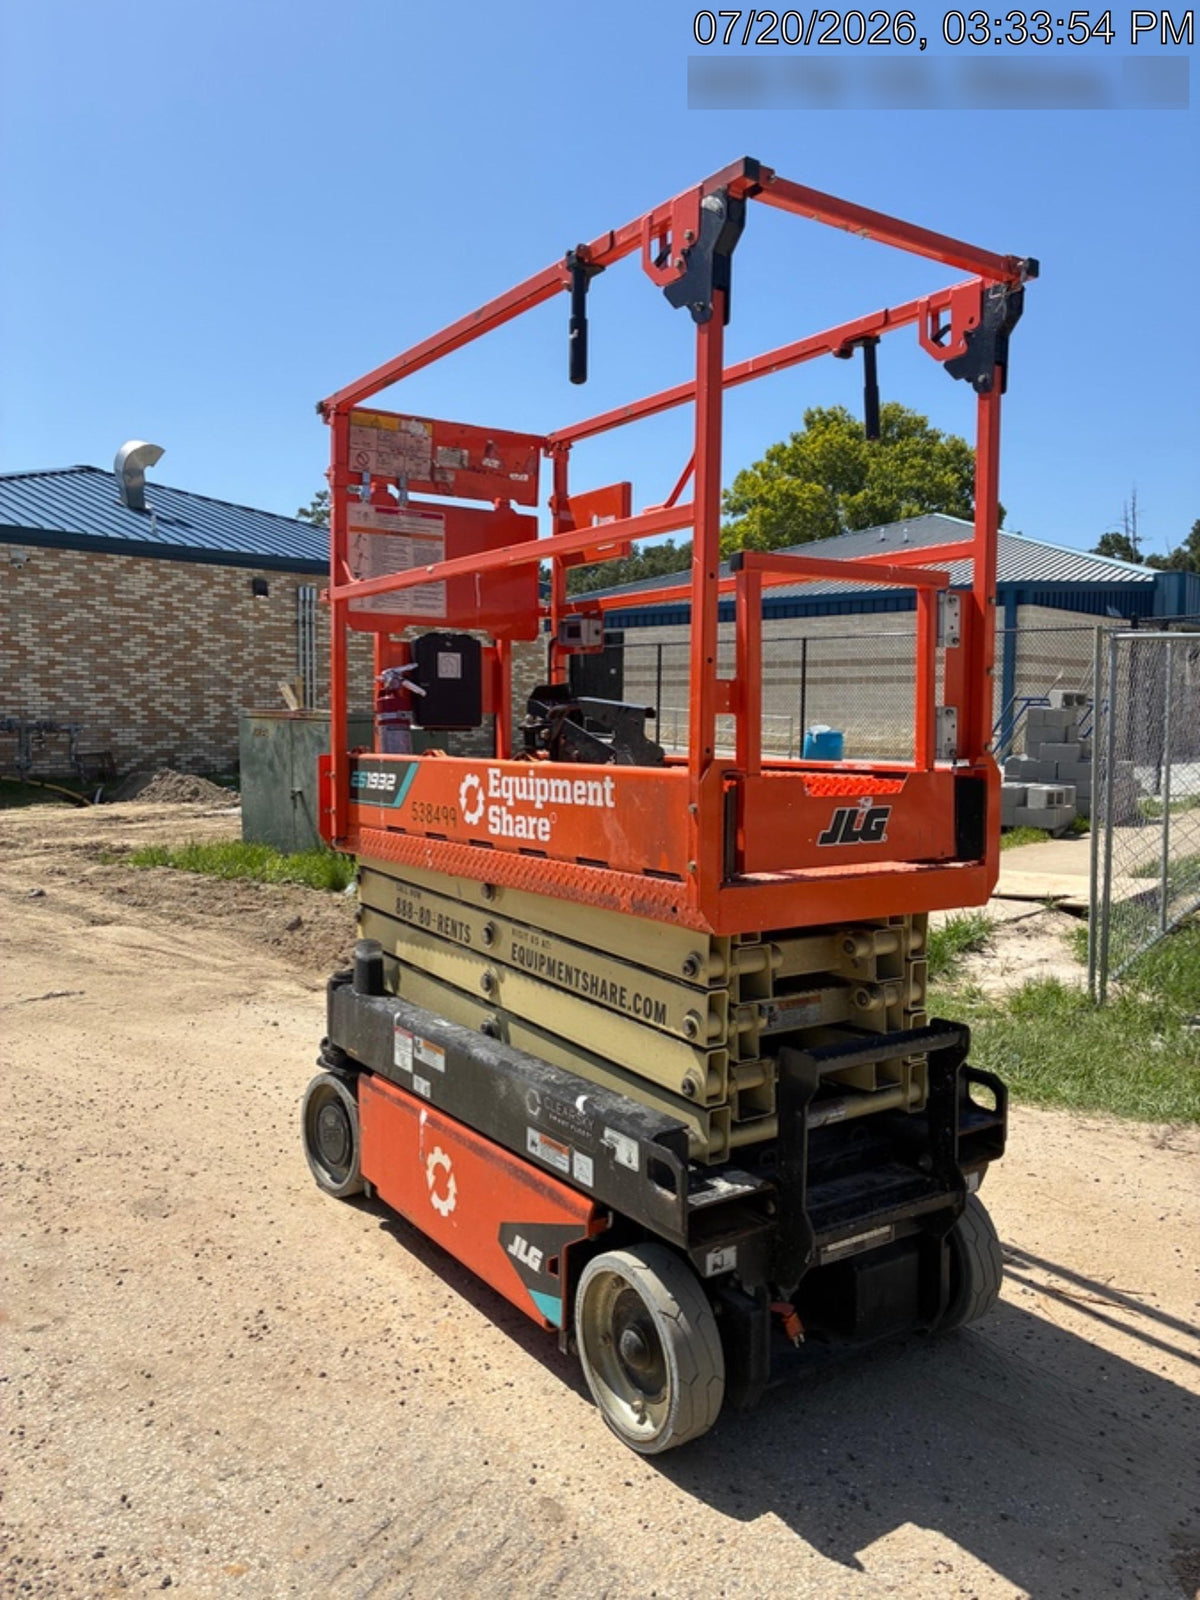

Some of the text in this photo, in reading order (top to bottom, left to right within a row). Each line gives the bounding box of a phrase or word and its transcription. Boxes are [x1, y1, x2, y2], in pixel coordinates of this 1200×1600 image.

[487, 767, 616, 809] Equipment
[411, 801, 458, 828] 538499
[487, 804, 551, 842] Share
[817, 805, 893, 846] JLG
[395, 897, 472, 944] 888-80-RENTS
[511, 941, 667, 1026] EQUIPMENTSHARE.COM
[507, 1234, 544, 1272] JLG
